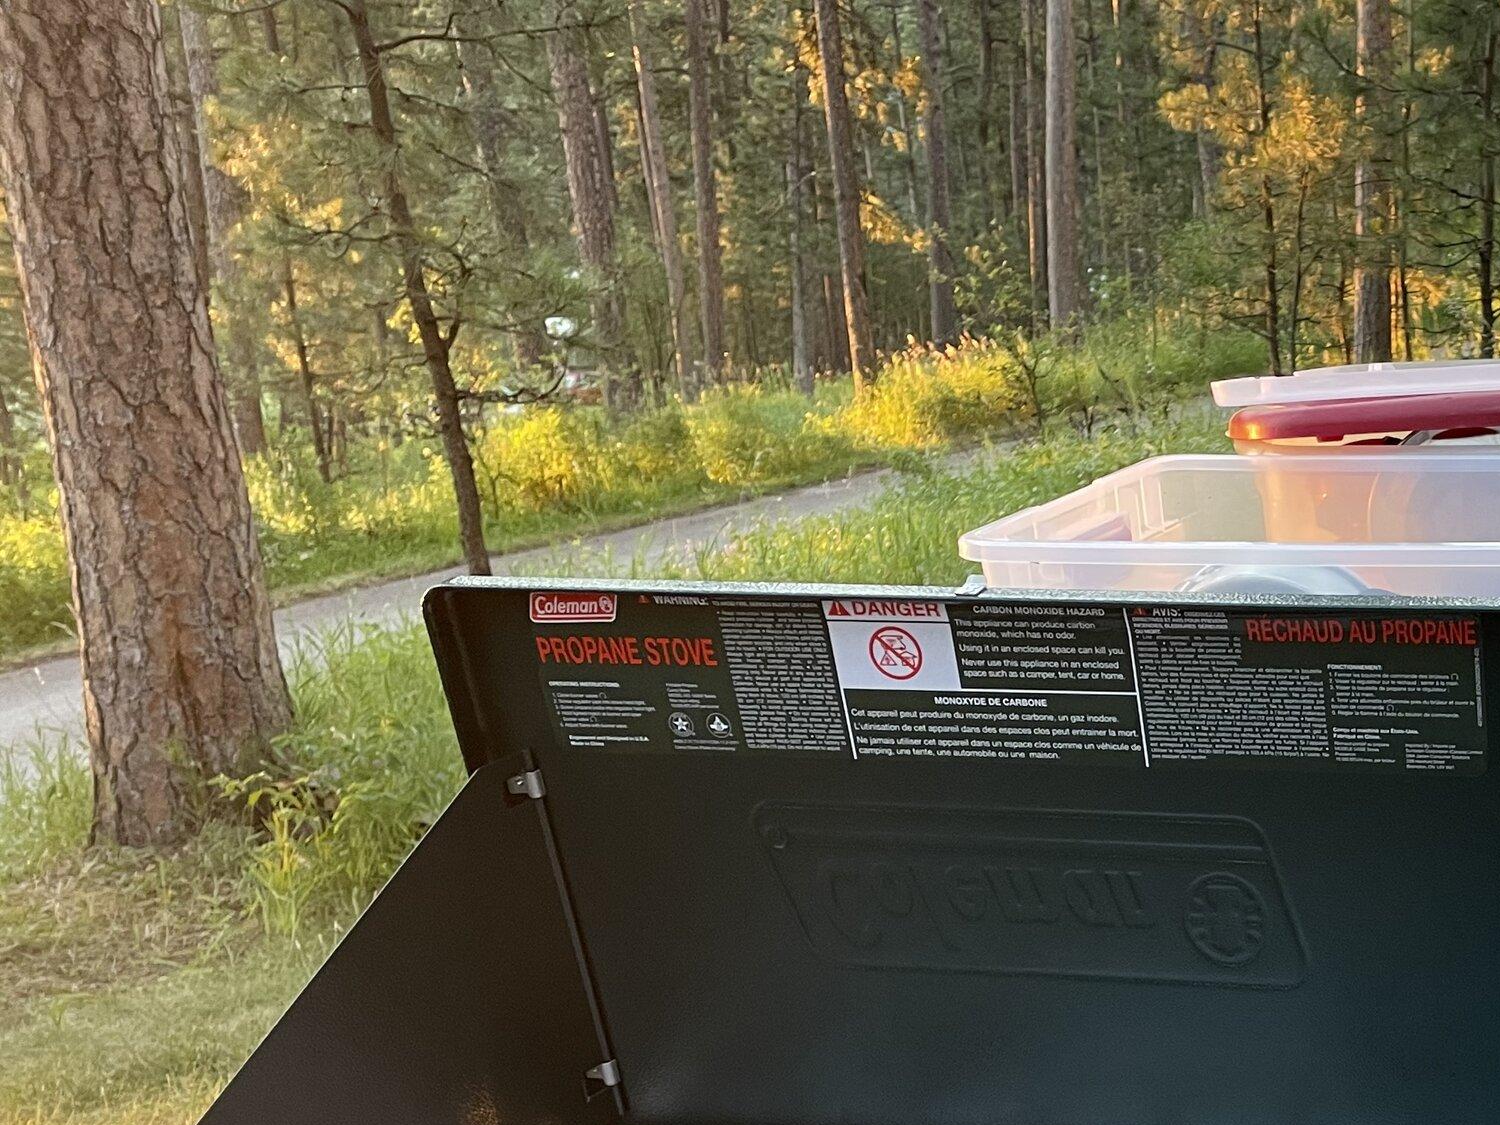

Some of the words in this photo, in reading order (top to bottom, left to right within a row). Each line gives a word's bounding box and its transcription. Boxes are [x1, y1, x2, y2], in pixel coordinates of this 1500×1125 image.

[534, 597, 598, 615] Coleman
[852, 601, 941, 616] DANGER
[973, 606, 1012, 614] CARBON
[1015, 607, 1065, 615] MONOXIDE
[1067, 608, 1105, 616] HAZARD
[1153, 608, 1181, 616] AVIS:
[954, 619, 971, 627] This
[974, 620, 1012, 628] appliance
[1031, 621, 1064, 629] produce
[957, 630, 999, 638] monoxide,
[1056, 632, 1076, 640] odor.
[1351, 619, 1376, 643] AU
[1383, 620, 1477, 645] PROPANE
[535, 636, 643, 665] PROPANE
[646, 637, 718, 666] STOVE
[959, 644, 983, 654] Using
[1051, 647, 1076, 655] space
[1108, 648, 1125, 656] you.
[962, 658, 985, 667] Never
[1004, 659, 1018, 667] this
[1020, 660, 1059, 669] appliance
[1083, 661, 1119, 669] enclosed
[964, 670, 987, 678] space
[989, 670, 1007, 678] such
[1026, 672, 1057, 680] camper,
[934, 696, 986, 705] MONOXYDE
[1003, 698, 1047, 707] CARBONE
[851, 708, 865, 716] Cet
[867, 710, 898, 718] appareil
[919, 711, 952, 719] produire
[954, 711, 964, 719] du
[966, 712, 1008, 722] monoxyde
[1022, 713, 1057, 722] carbone,
[1087, 715, 1119, 723] inodore.
[902, 724, 912, 732] de
[914, 724, 926, 732] cet
[928, 725, 959, 733] appareil
[961, 725, 980, 733] dans
[982, 726, 997, 734] des
[999, 727, 1032, 735] espaces
[1034, 727, 1050, 735] clos
[1052, 727, 1071, 736] peut
[870, 736, 895, 745] jamais
[924, 738, 936, 746] cet
[938, 738, 969, 746] appareil
[971, 739, 990, 747] dans
[1004, 741, 1032, 749] espace
[1034, 741, 1051, 749] clos
[1053, 742, 1082, 750] comme
[1131, 743, 1141, 751] de
[859, 748, 895, 756] camping,
[953, 749, 996, 758] automobile
